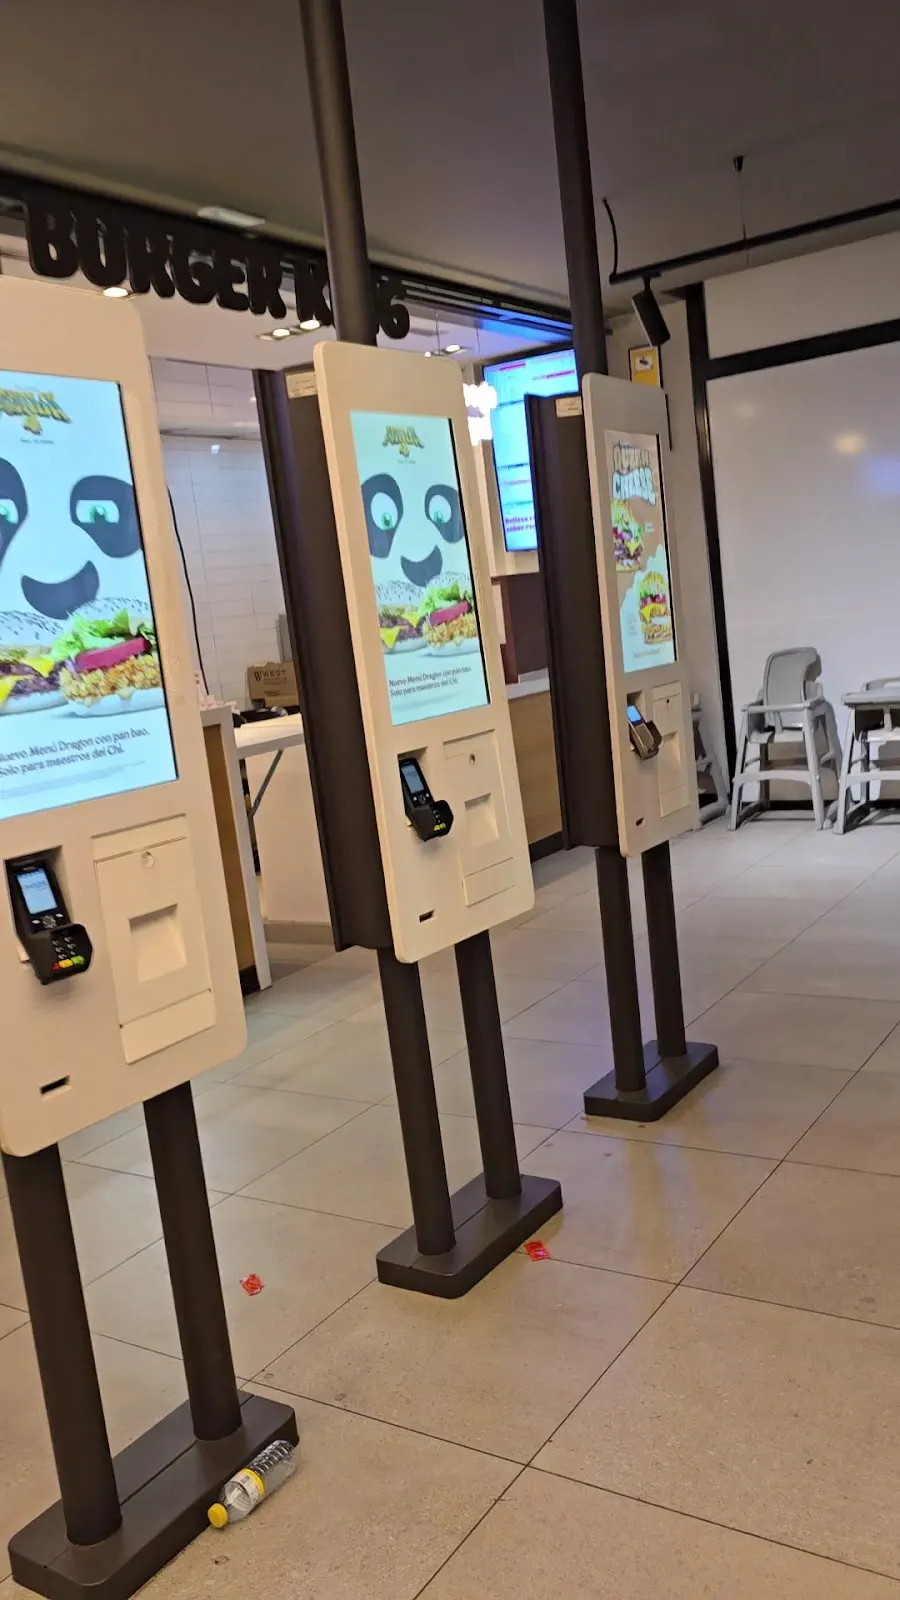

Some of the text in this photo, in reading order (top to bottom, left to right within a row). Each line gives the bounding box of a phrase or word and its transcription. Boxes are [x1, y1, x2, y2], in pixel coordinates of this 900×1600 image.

[25, 196, 411, 340] BURGER KG
[388, 679, 407, 687] Nuevo
[442, 669, 452, 677] con
[390, 689, 403, 698] Solo
[402, 687, 416, 696] para
[416, 683, 441, 692] maestros
[441, 679, 451, 687] del
[95, 734, 112, 744] con
[112, 731, 130, 743] pan
[21, 761, 45, 775] para
[46, 752, 91, 767] maestros
[92, 747, 106, 759] del
[108, 743, 125, 755] Chi.
